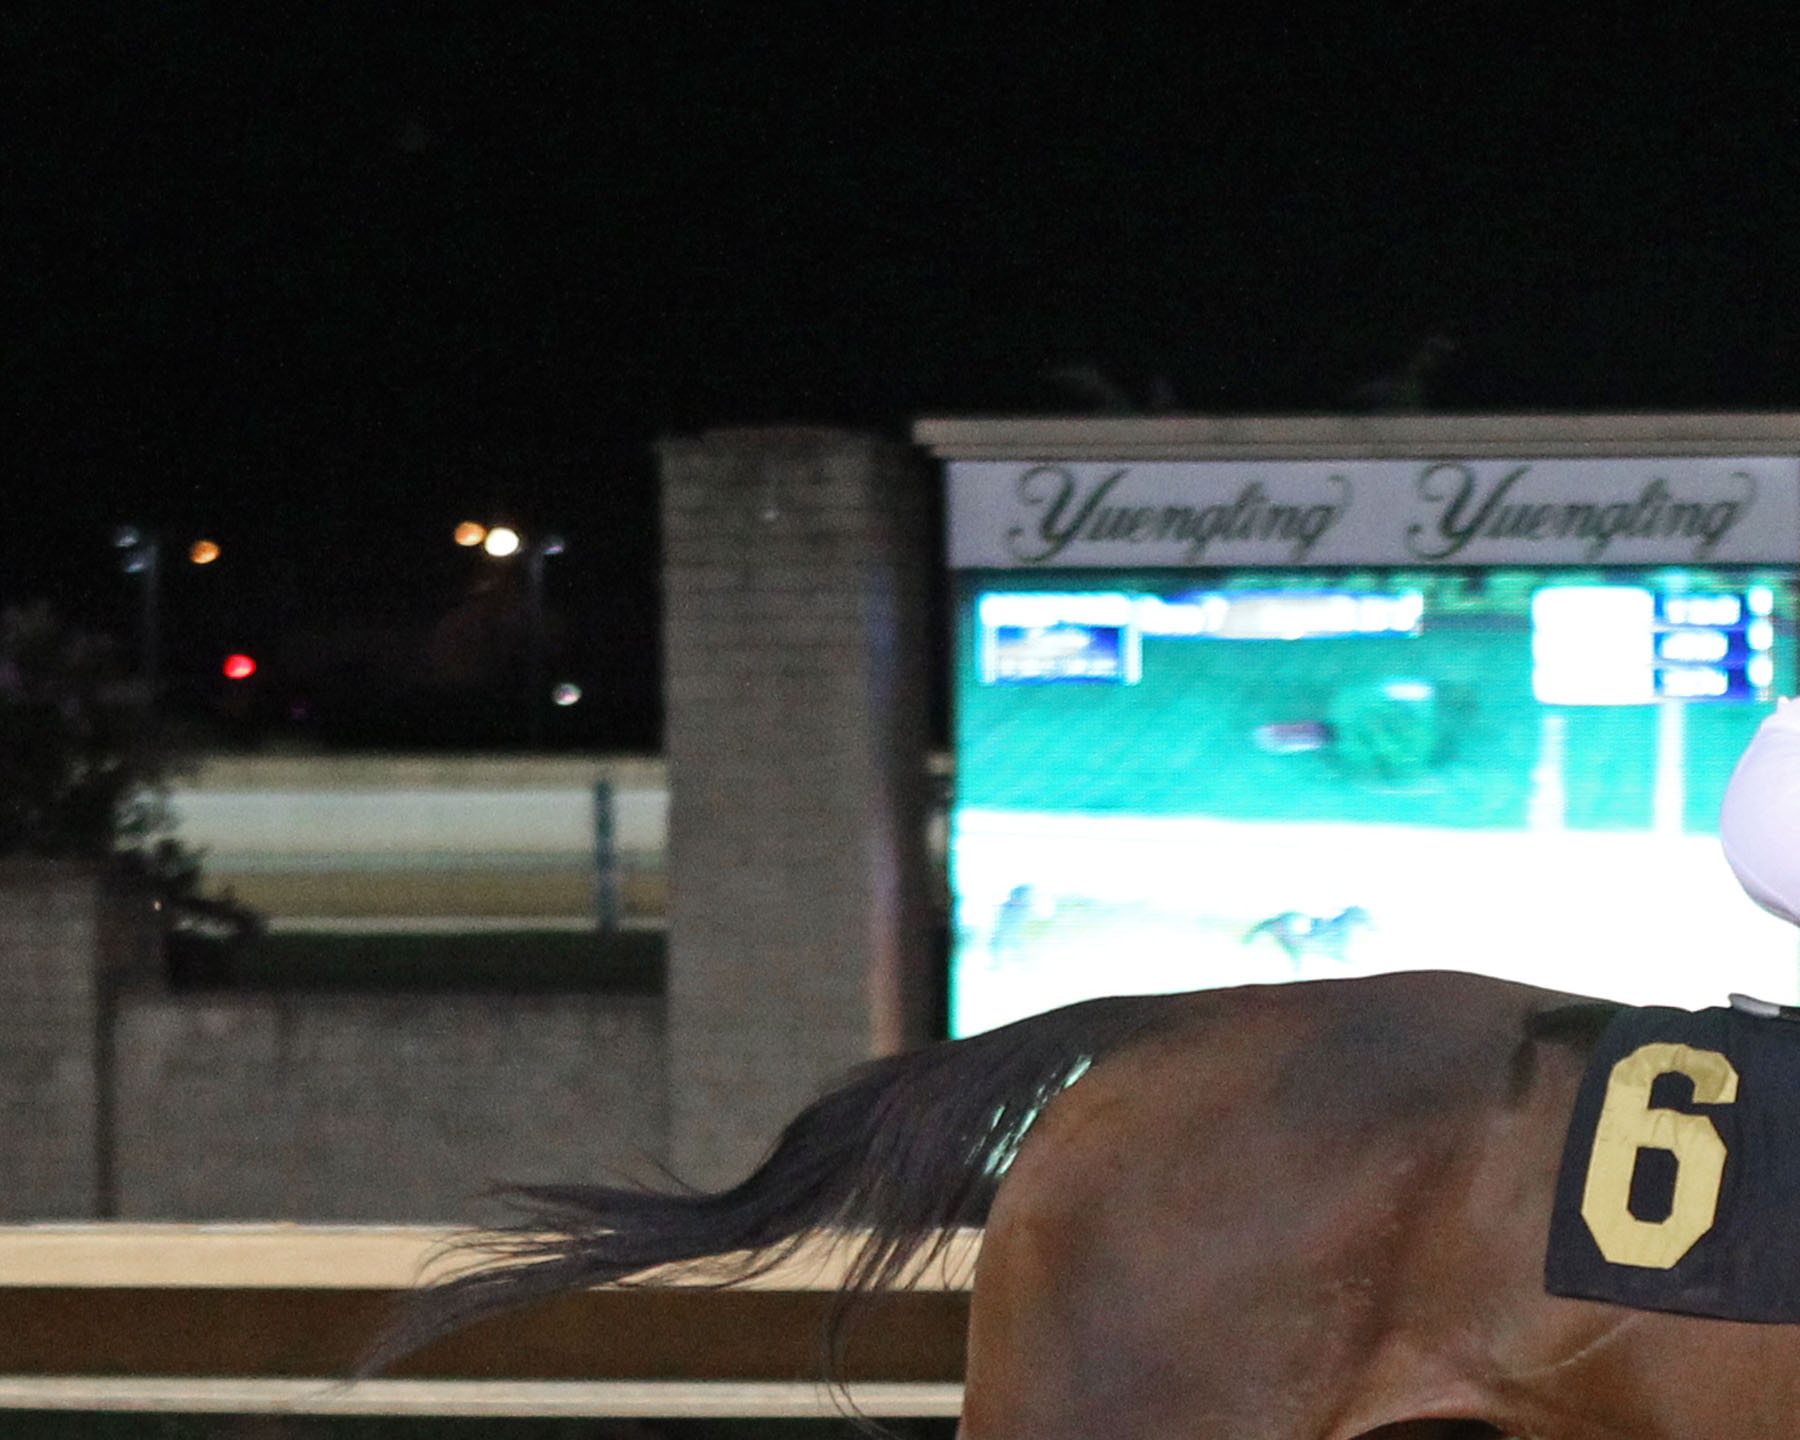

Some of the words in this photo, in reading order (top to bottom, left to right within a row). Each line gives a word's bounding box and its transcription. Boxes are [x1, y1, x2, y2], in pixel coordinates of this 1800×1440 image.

[1006, 464, 1353, 565] Yuengling
[1405, 462, 1757, 562] Yuengling
[1581, 1042, 1739, 1269] 6
